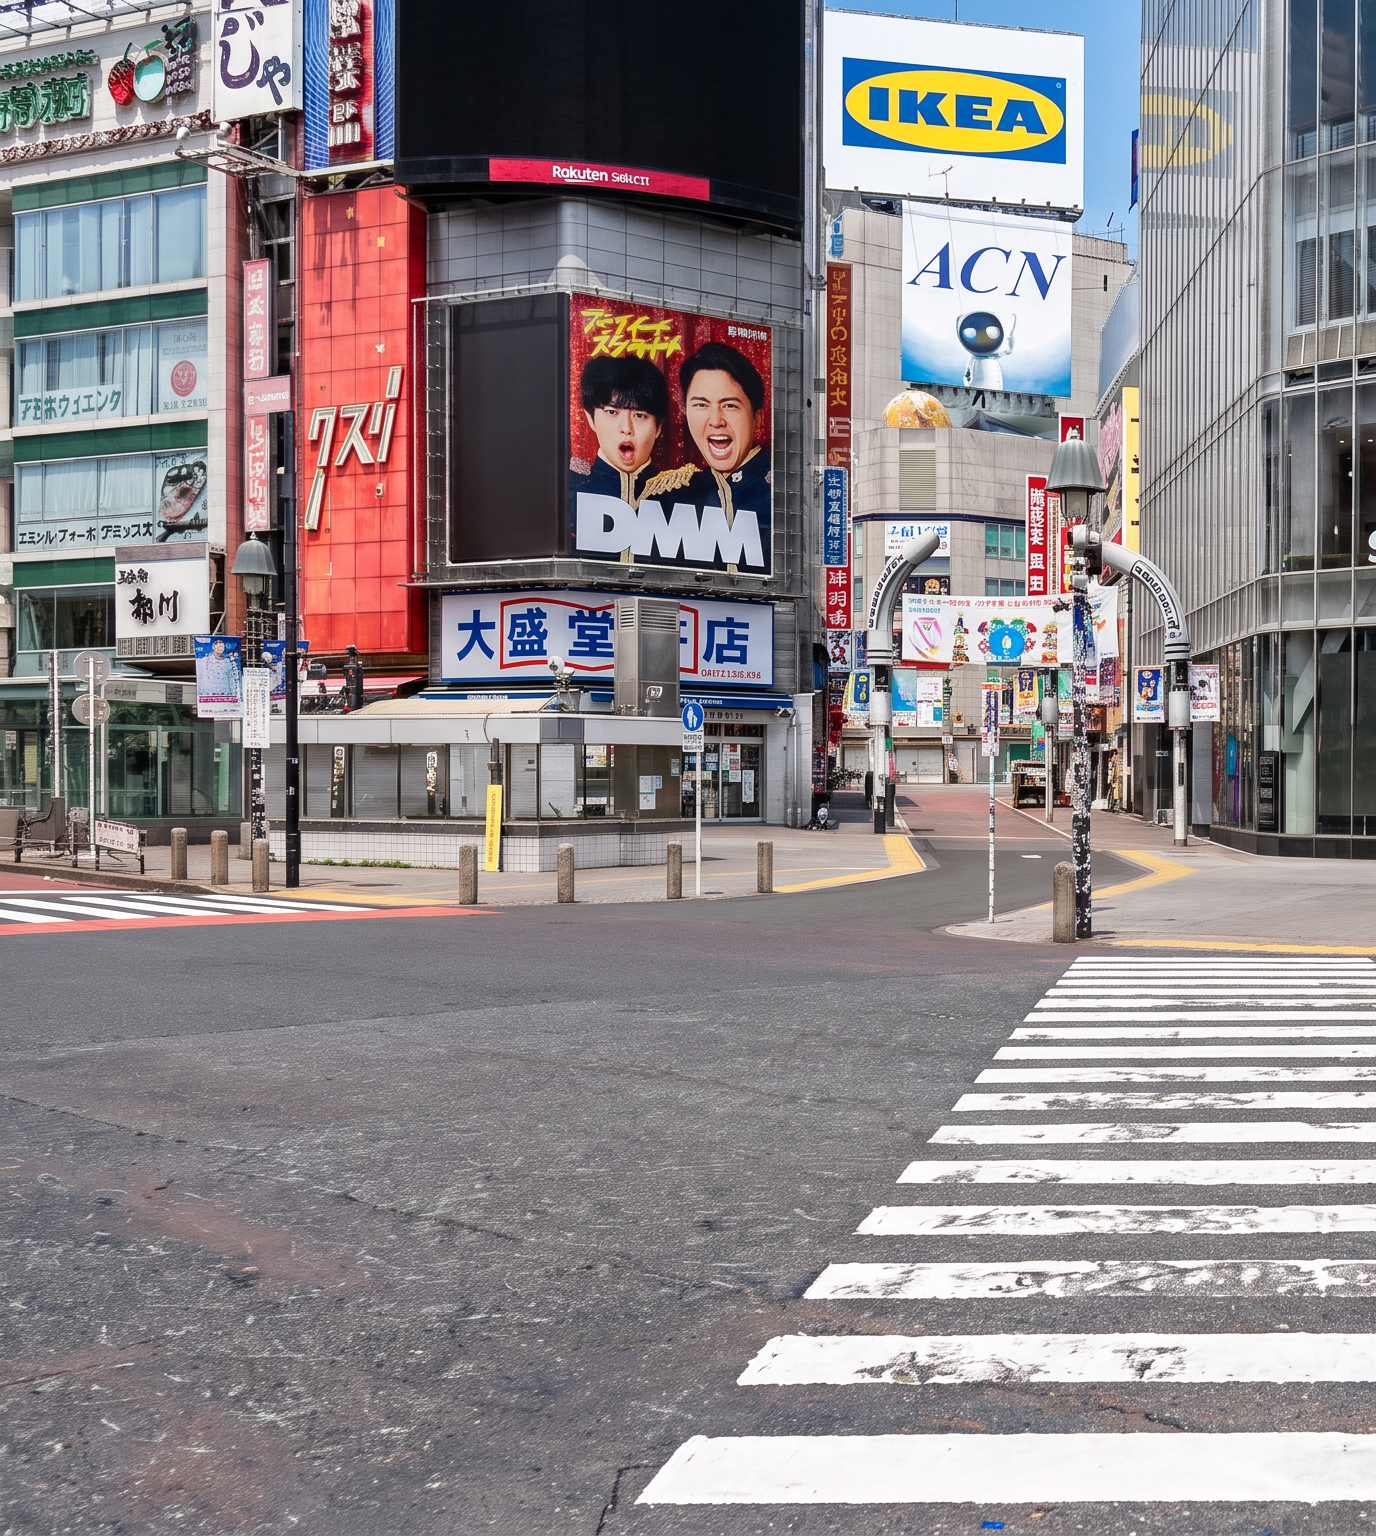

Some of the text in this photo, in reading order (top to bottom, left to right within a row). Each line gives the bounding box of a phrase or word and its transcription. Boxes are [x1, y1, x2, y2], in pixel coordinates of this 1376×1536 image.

[217, 0, 291, 105] じゃ
[868, 86, 1048, 136] IKEA
[552, 165, 608, 182] Rakuten
[906, 242, 1067, 301] ACN
[576, 491, 764, 567] DMM
[456, 607, 750, 665] 大盛堂店
